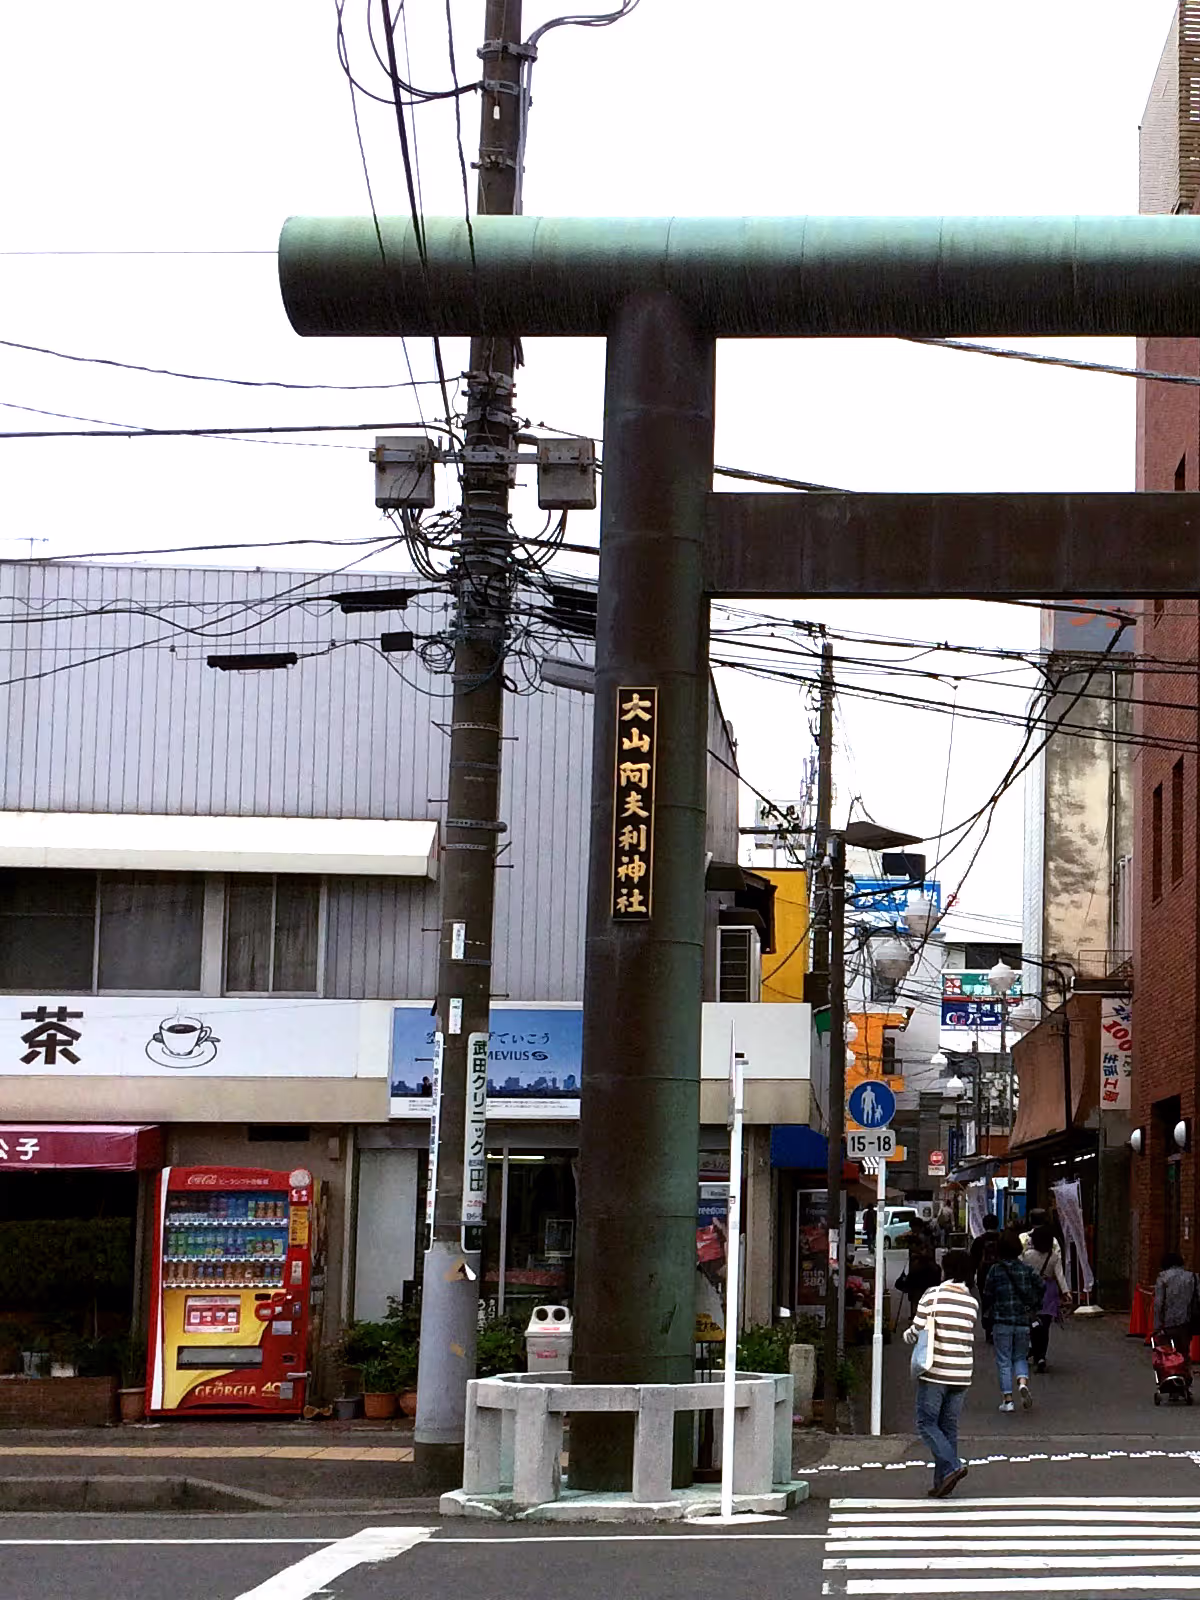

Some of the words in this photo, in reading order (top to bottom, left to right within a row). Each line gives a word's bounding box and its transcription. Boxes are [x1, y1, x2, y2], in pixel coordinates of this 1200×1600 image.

[616, 693, 652, 913] 大山阿夫利神社
[20, 1006, 83, 1065] 茶
[488, 1050, 530, 1061] MEVIUS
[472, 1040, 489, 1156] 武田クリニック
[850, 1136, 892, 1152] 15-18
[195, 1385, 257, 1397] GEORGIA
